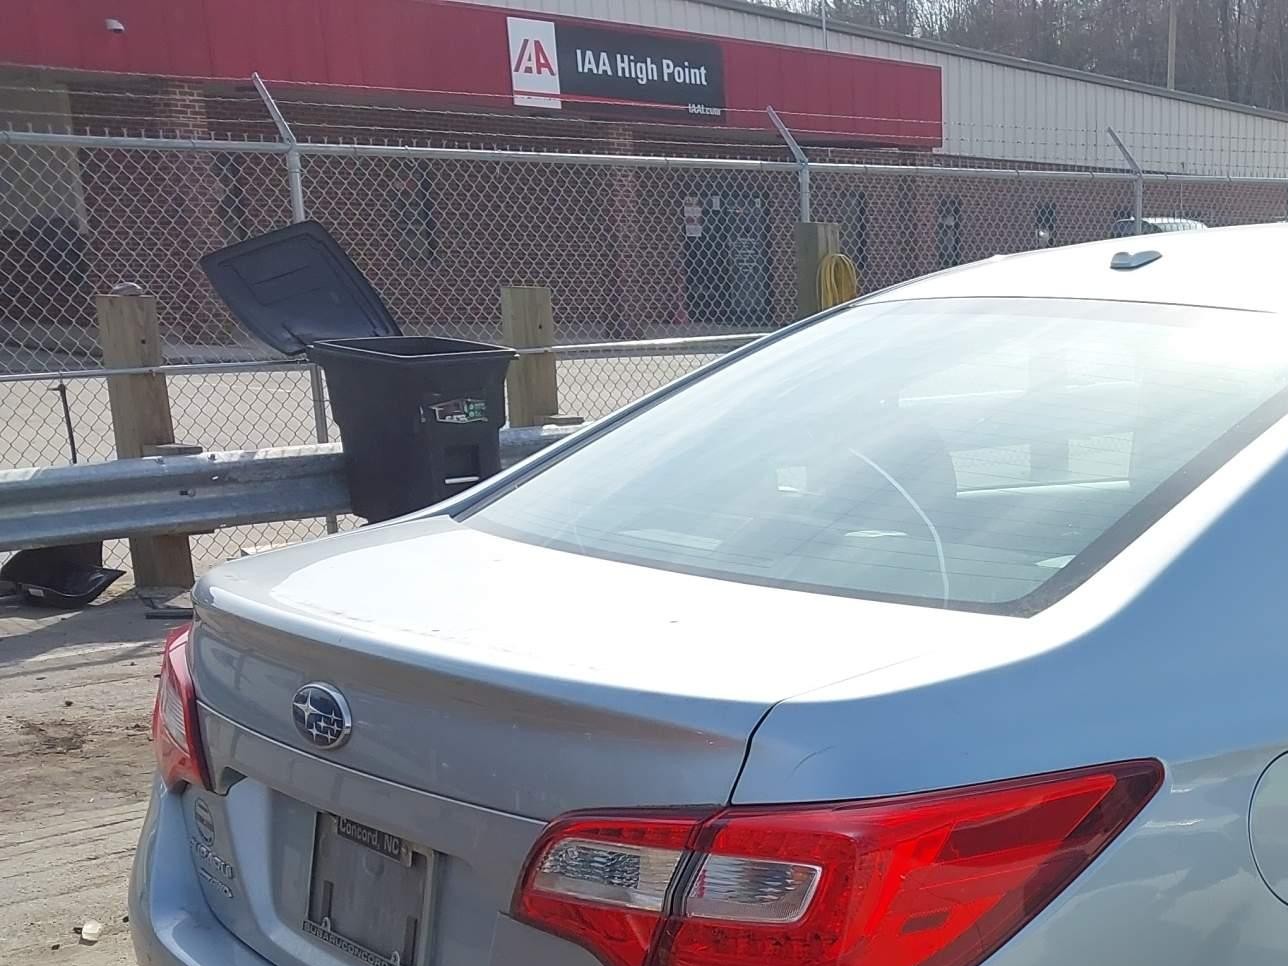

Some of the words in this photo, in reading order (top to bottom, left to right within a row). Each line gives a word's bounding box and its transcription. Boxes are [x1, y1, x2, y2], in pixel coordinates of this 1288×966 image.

[576, 49, 612, 75] IAA
[616, 54, 658, 84] High
[662, 59, 708, 86] Point
[339, 817, 381, 849] Concord,
[384, 834, 400, 854] NC
